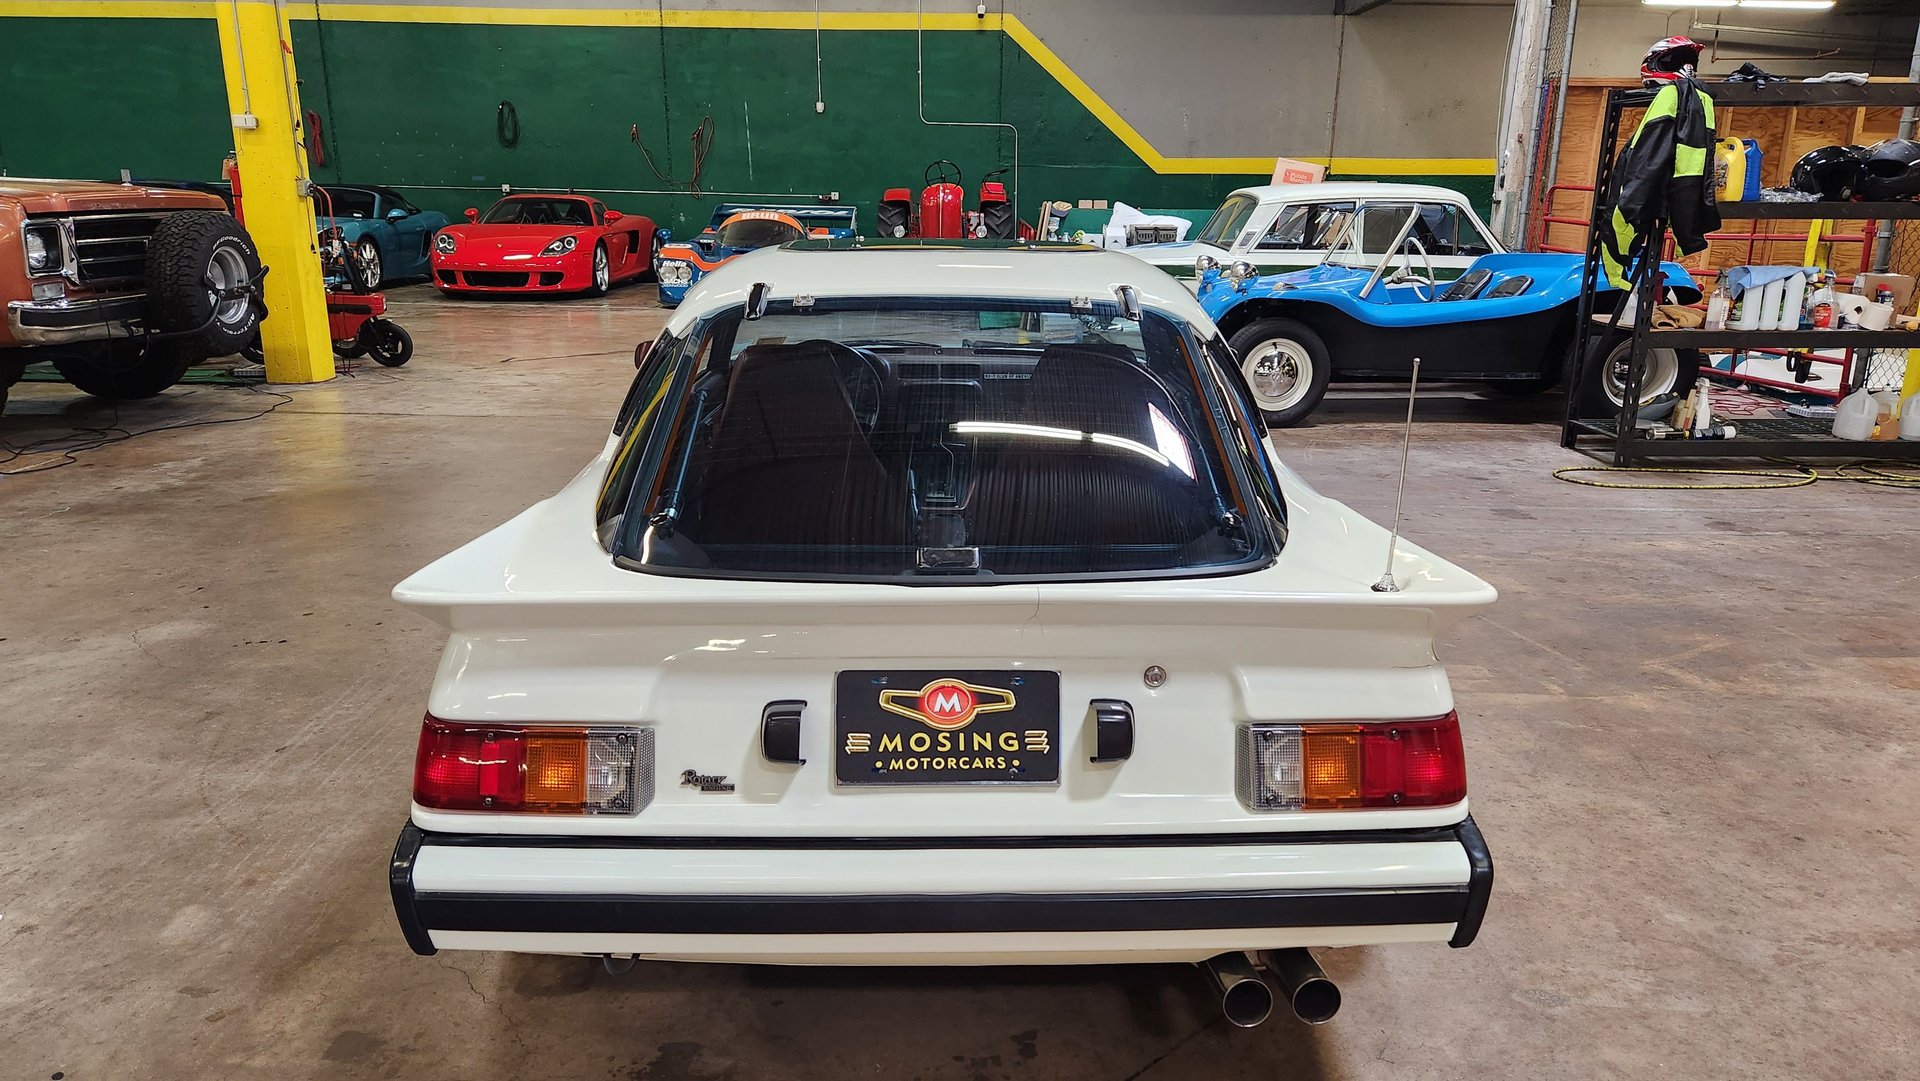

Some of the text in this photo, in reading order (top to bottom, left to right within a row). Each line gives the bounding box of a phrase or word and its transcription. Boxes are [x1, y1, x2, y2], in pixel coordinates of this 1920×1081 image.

[741, 211, 779, 220] BRUN
[934, 692, 962, 713] M
[878, 732, 1020, 753] MOSING
[889, 756, 1007, 771] MOTORCARS
[681, 769, 728, 787] Rotary
